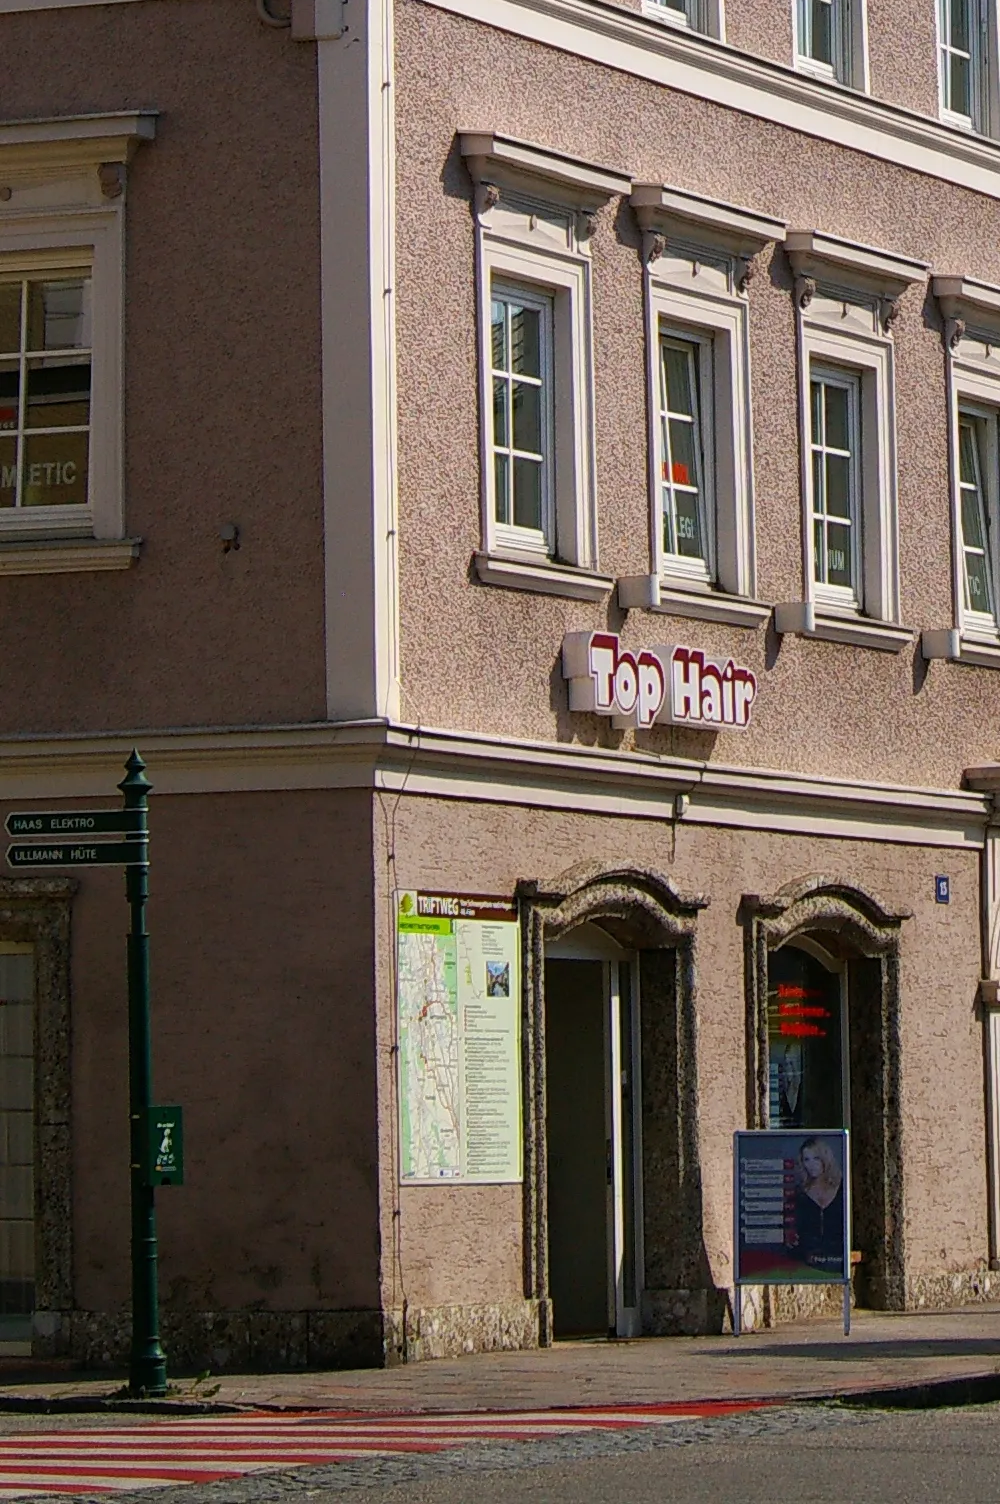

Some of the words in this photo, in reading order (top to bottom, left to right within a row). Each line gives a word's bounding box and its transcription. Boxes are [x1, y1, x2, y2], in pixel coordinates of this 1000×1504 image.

[590, 634, 664, 726] Top
[671, 646, 756, 726] Hair
[13, 819, 43, 830] HAAS
[50, 817, 95, 829] ELEKTRO
[14, 849, 63, 861] ULLMANN
[70, 846, 97, 860] HÜTE
[418, 895, 459, 916] TRIFTWEG
